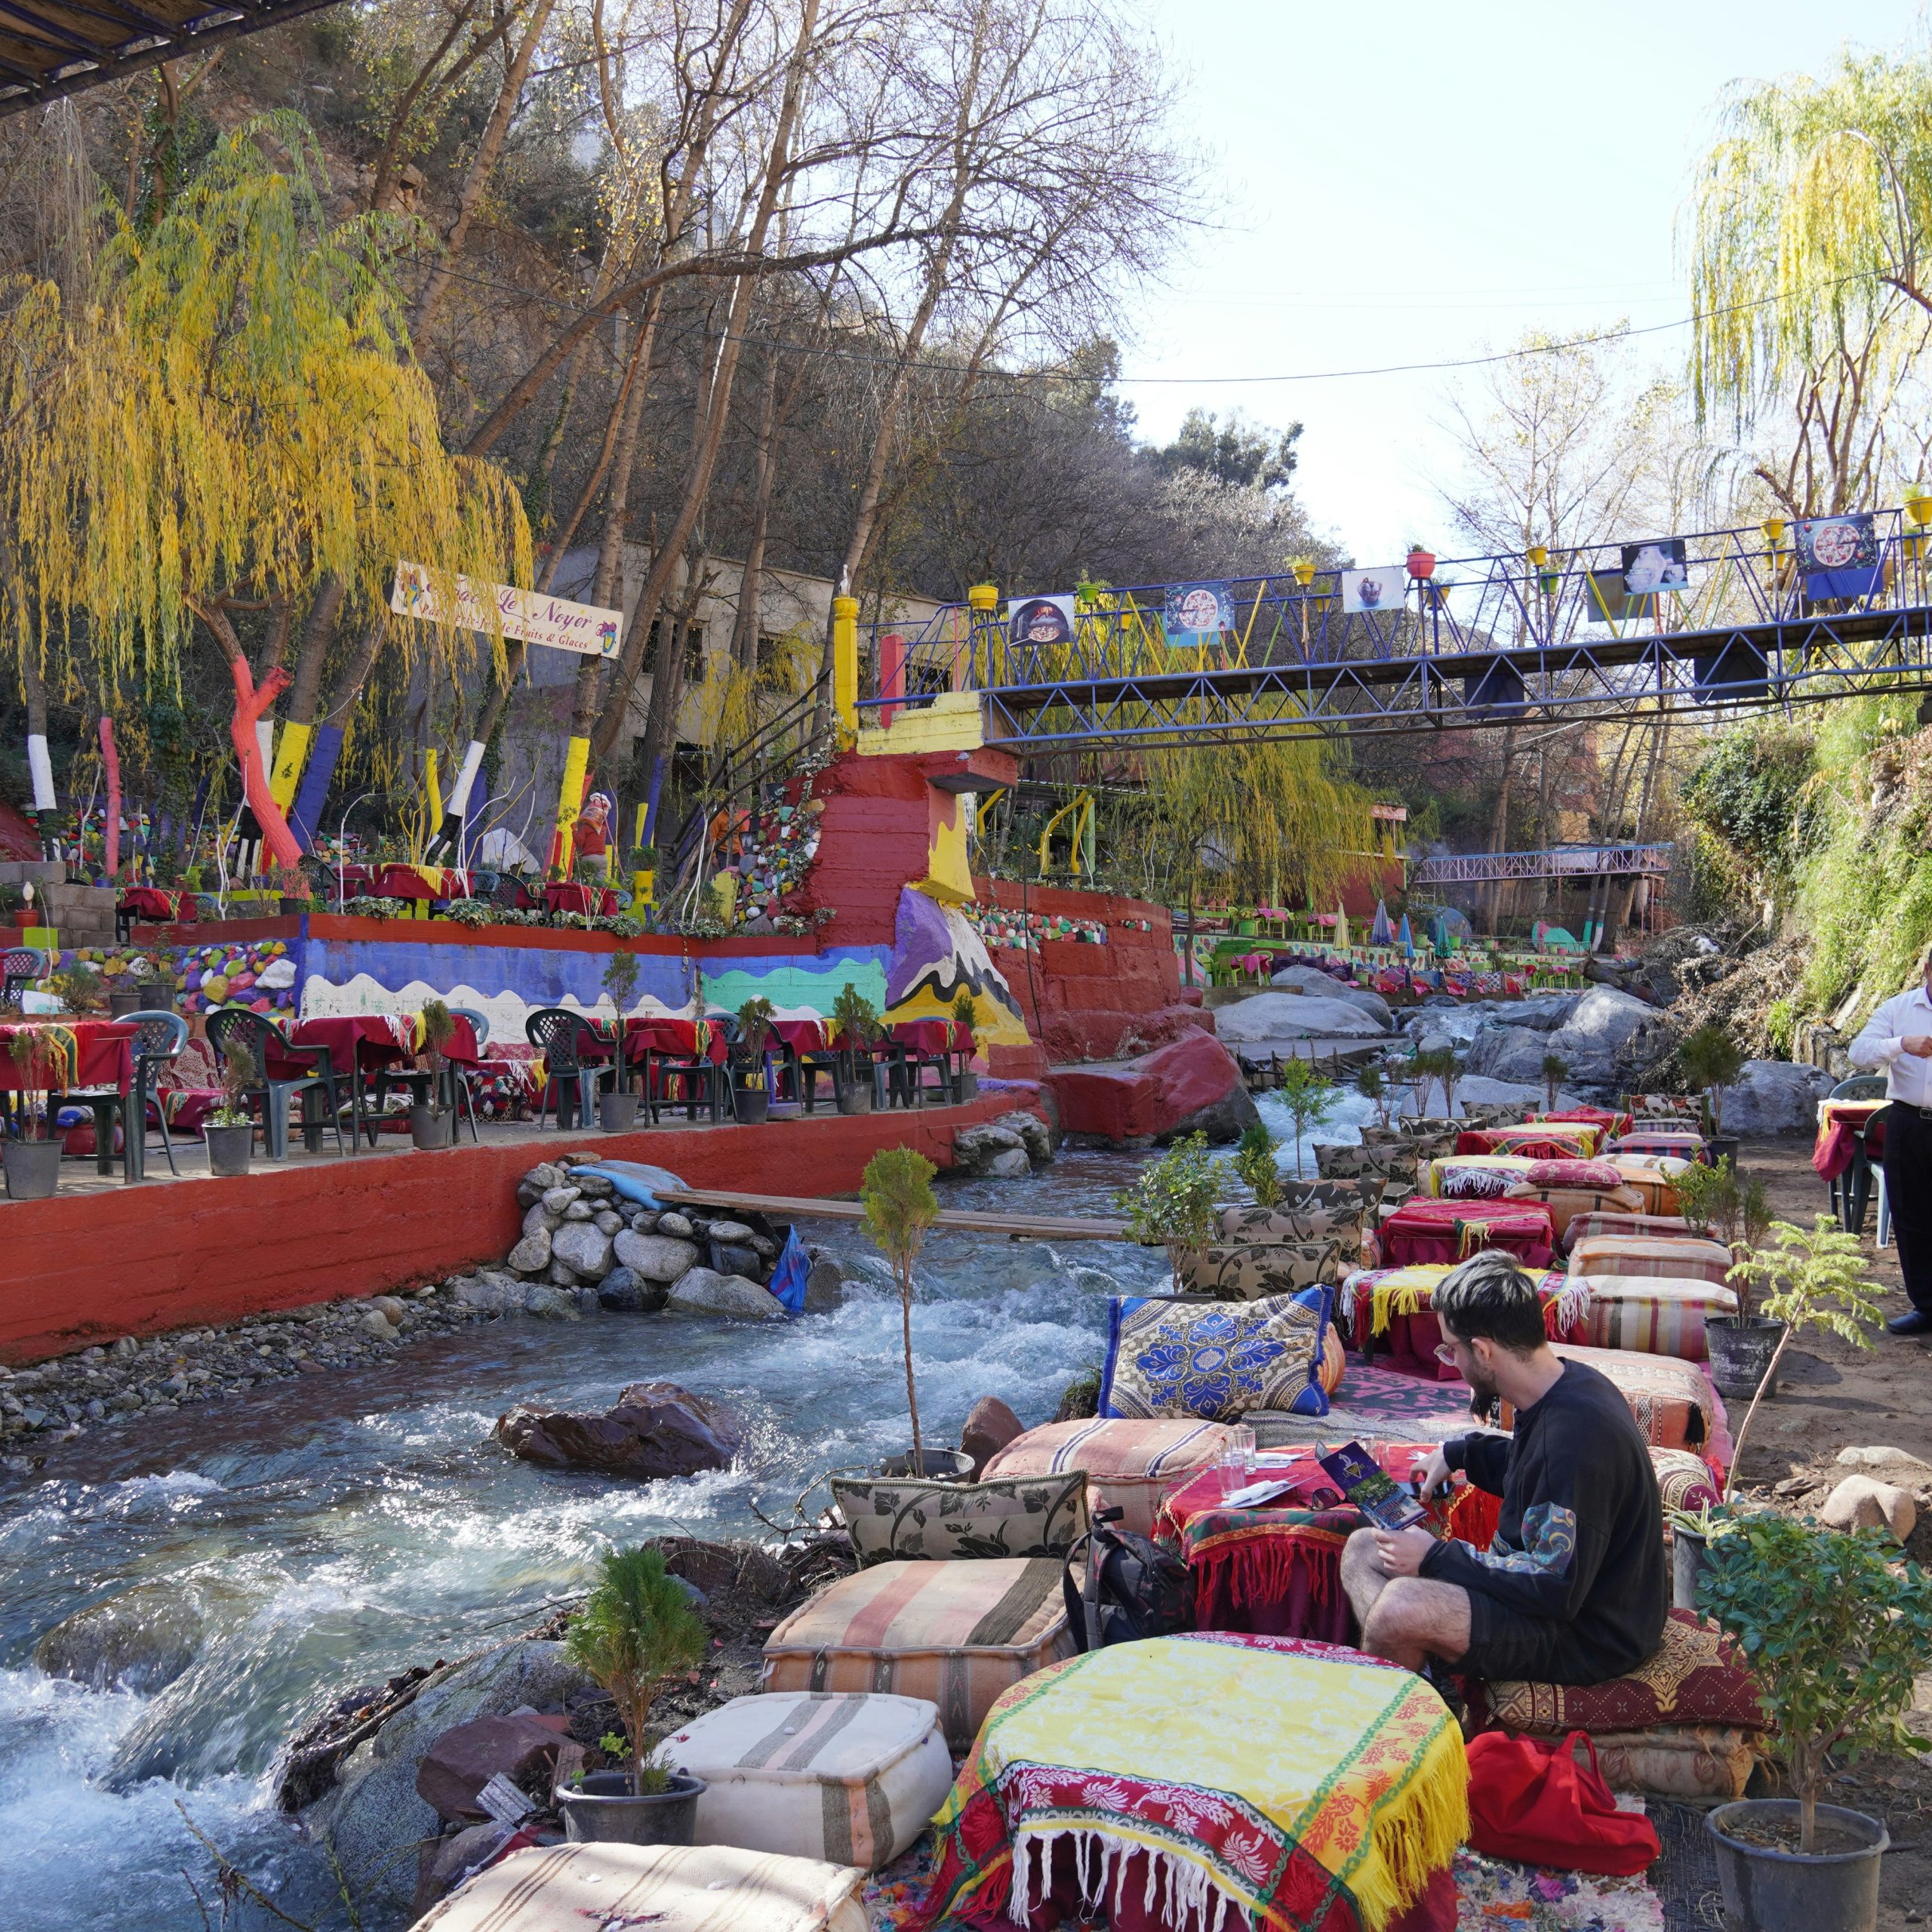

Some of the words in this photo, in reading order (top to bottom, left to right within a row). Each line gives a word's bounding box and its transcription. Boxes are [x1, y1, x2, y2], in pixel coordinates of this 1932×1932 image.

[532, 601, 592, 632] Noyer
[514, 623, 543, 640] Fruits
[546, 633, 555, 642] &
[558, 635, 589, 649] Glaces
